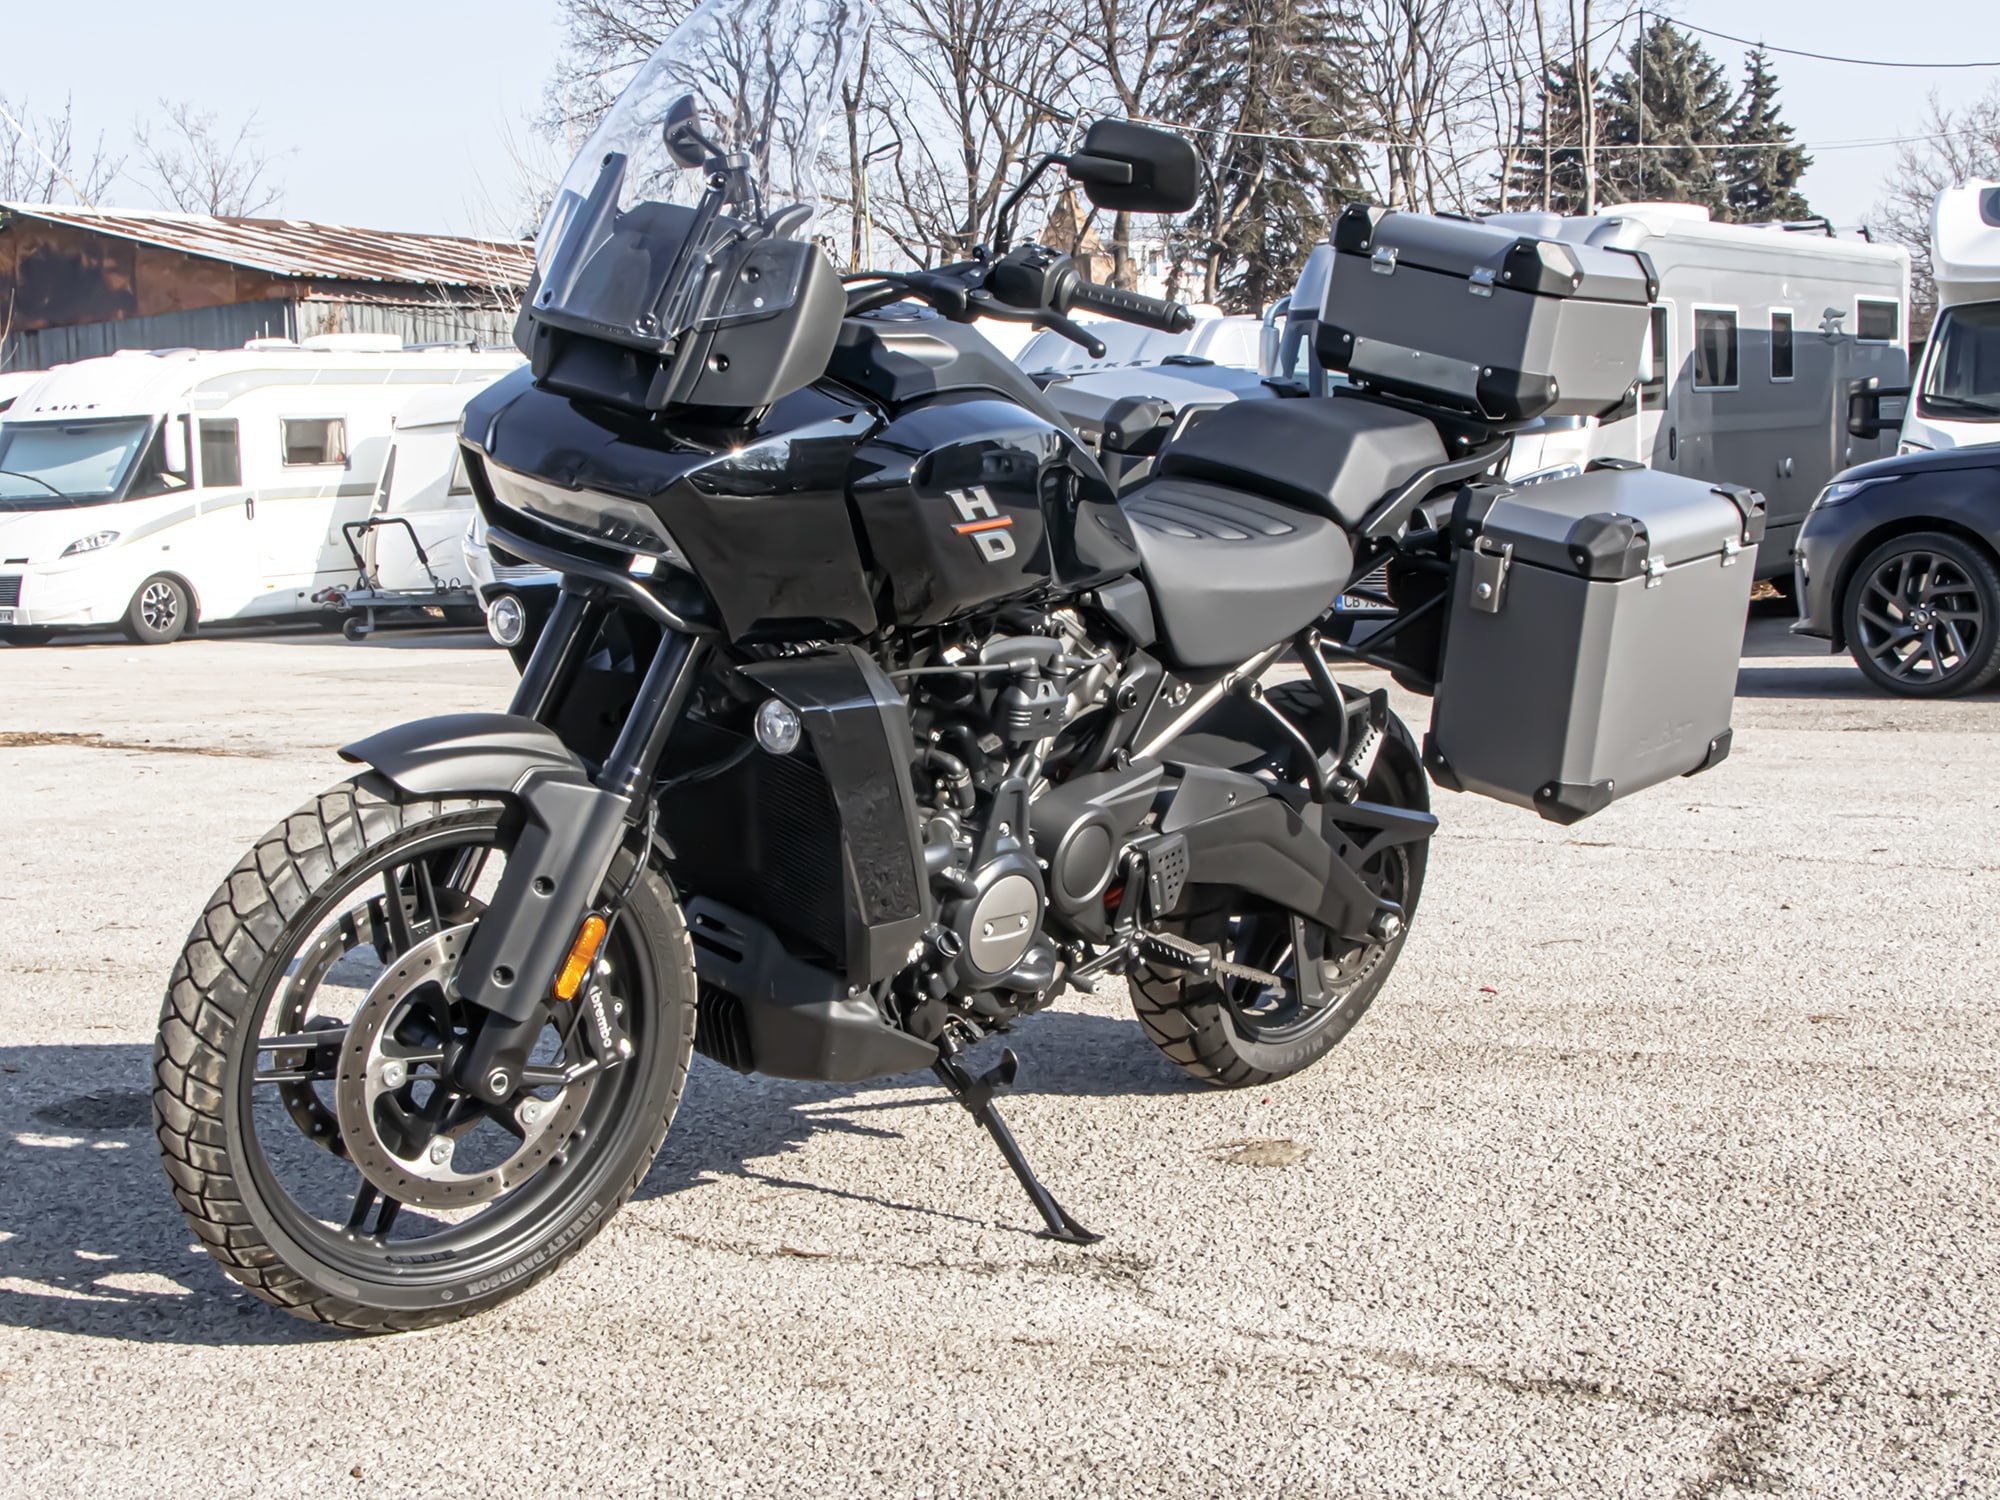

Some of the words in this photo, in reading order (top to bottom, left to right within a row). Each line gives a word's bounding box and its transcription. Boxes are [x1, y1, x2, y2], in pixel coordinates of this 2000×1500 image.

[945, 485, 999, 521] H
[970, 529, 1016, 563] D
[590, 989, 613, 1049] brembo
[466, 1201, 602, 1296] HARLEY-DAVIDSON
